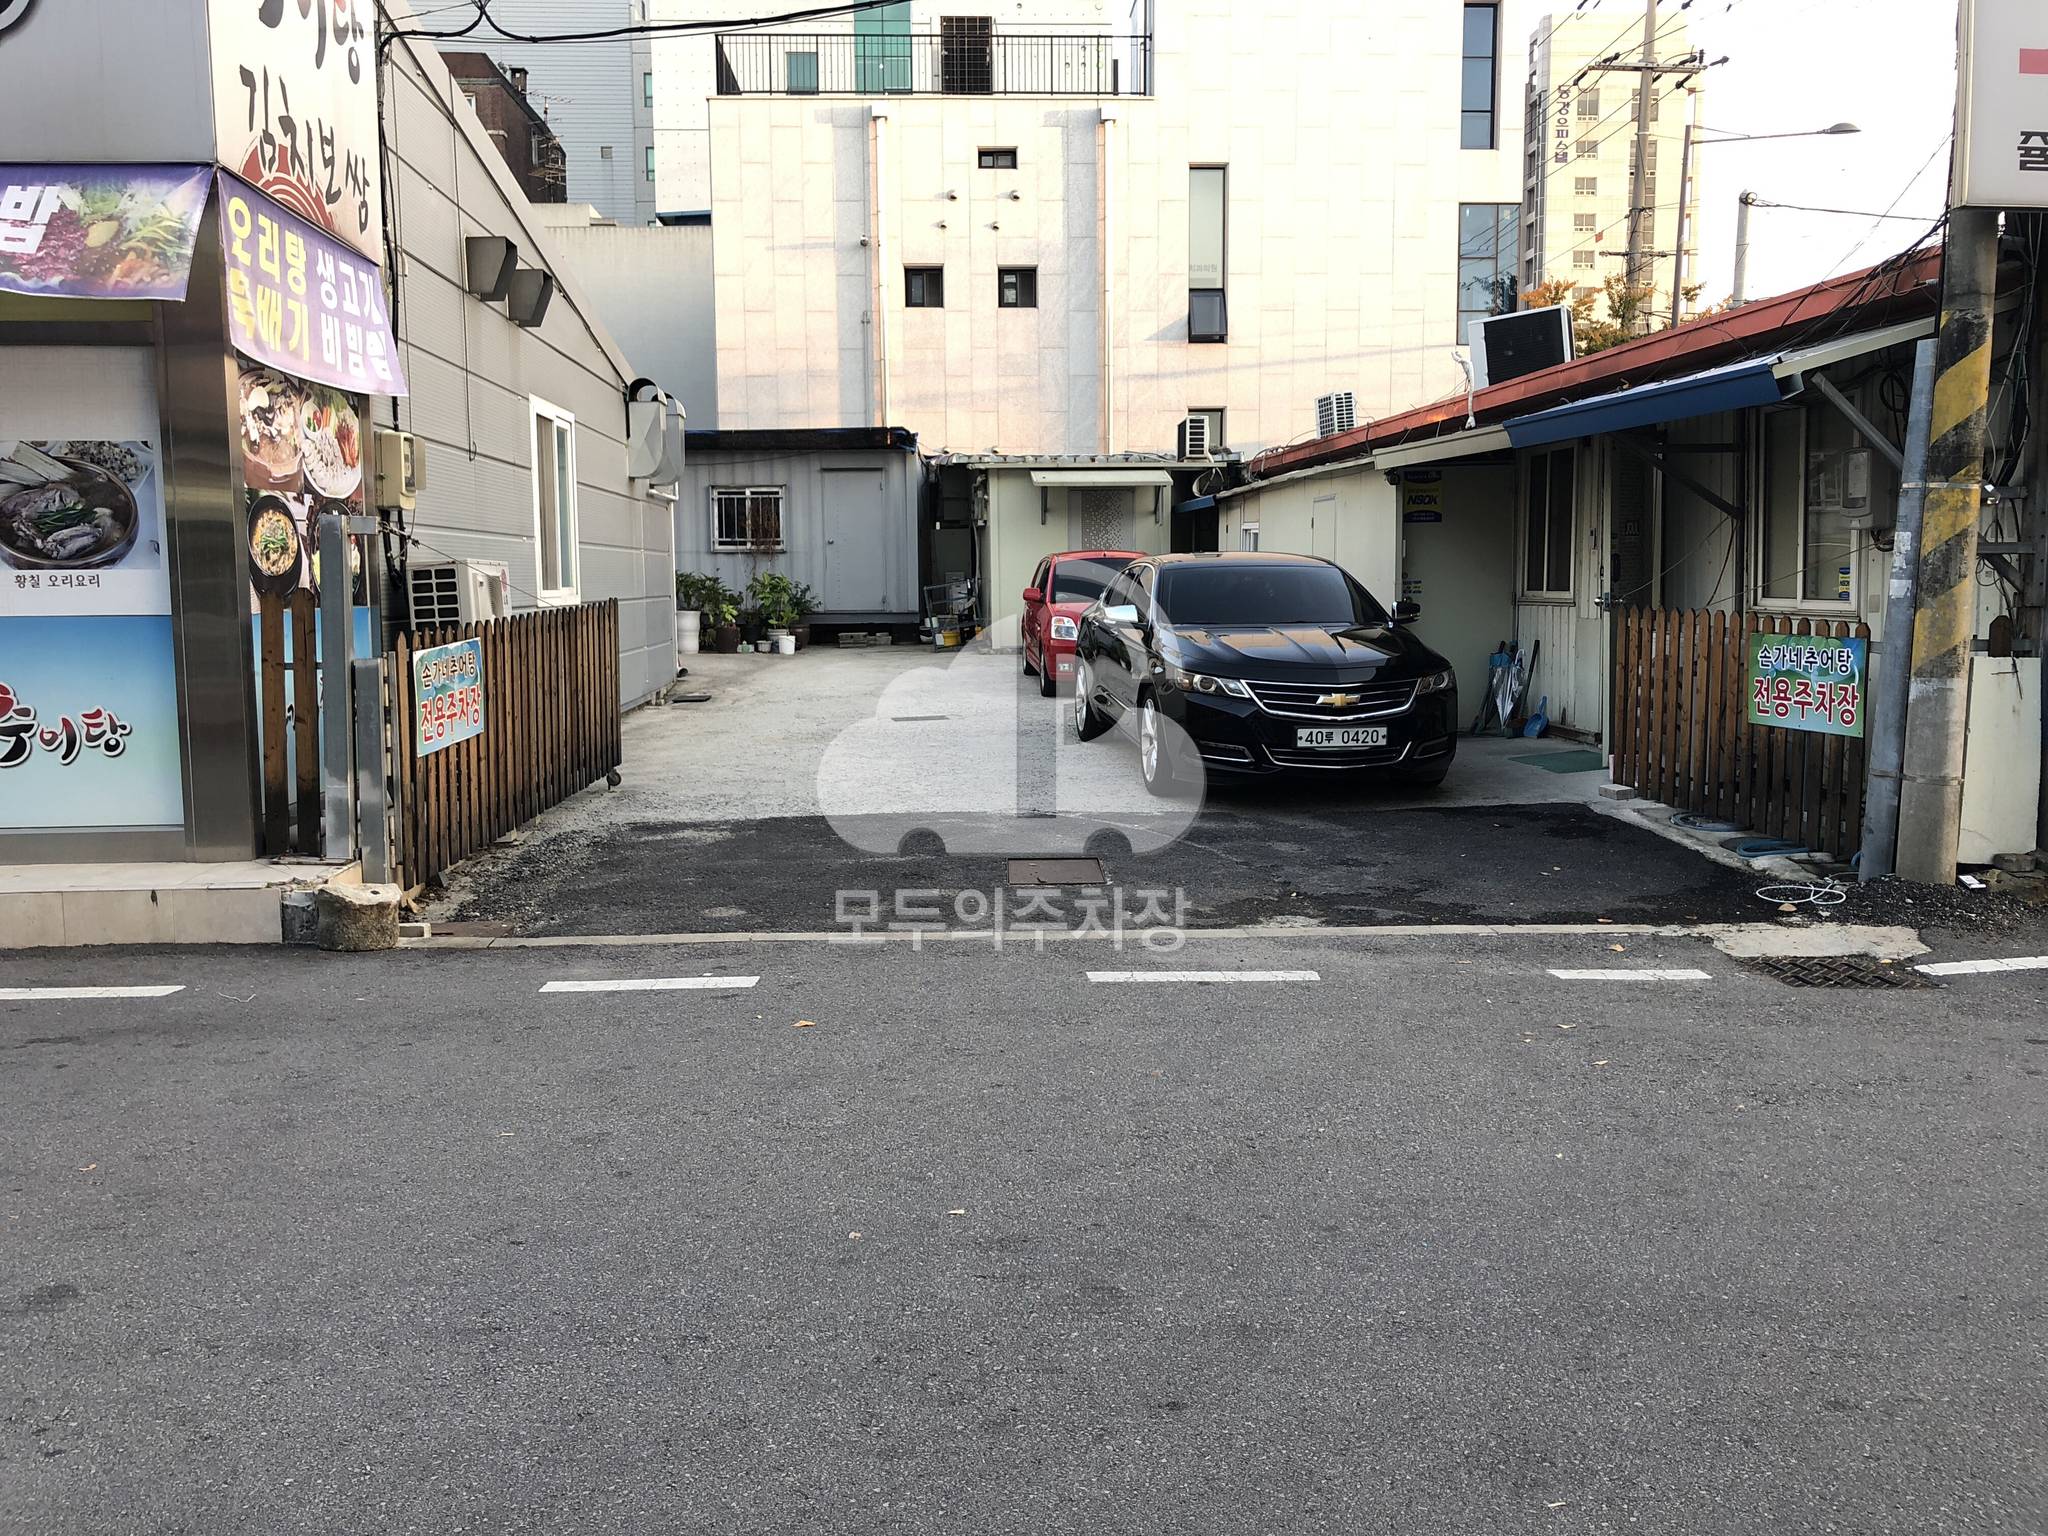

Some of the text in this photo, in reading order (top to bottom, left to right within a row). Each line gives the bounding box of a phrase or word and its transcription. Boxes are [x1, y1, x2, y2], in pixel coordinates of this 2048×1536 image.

[239, 64, 370, 234] 김치보쌈
[1554, 84, 1571, 163] 동강오피스텔
[228, 196, 307, 296] 오리탕
[316, 248, 383, 325] 생고기
[320, 312, 393, 381] 비빔밥
[14, 573, 101, 589] 황칠 오리요리
[422, 651, 476, 689] 손가네추어탕
[1759, 645, 1853, 675] 손가네추어탕
[421, 684, 480, 742] 전용주차장
[1753, 677, 1860, 726] 전용주차장
[1341, 729, 1379, 745] 0420
